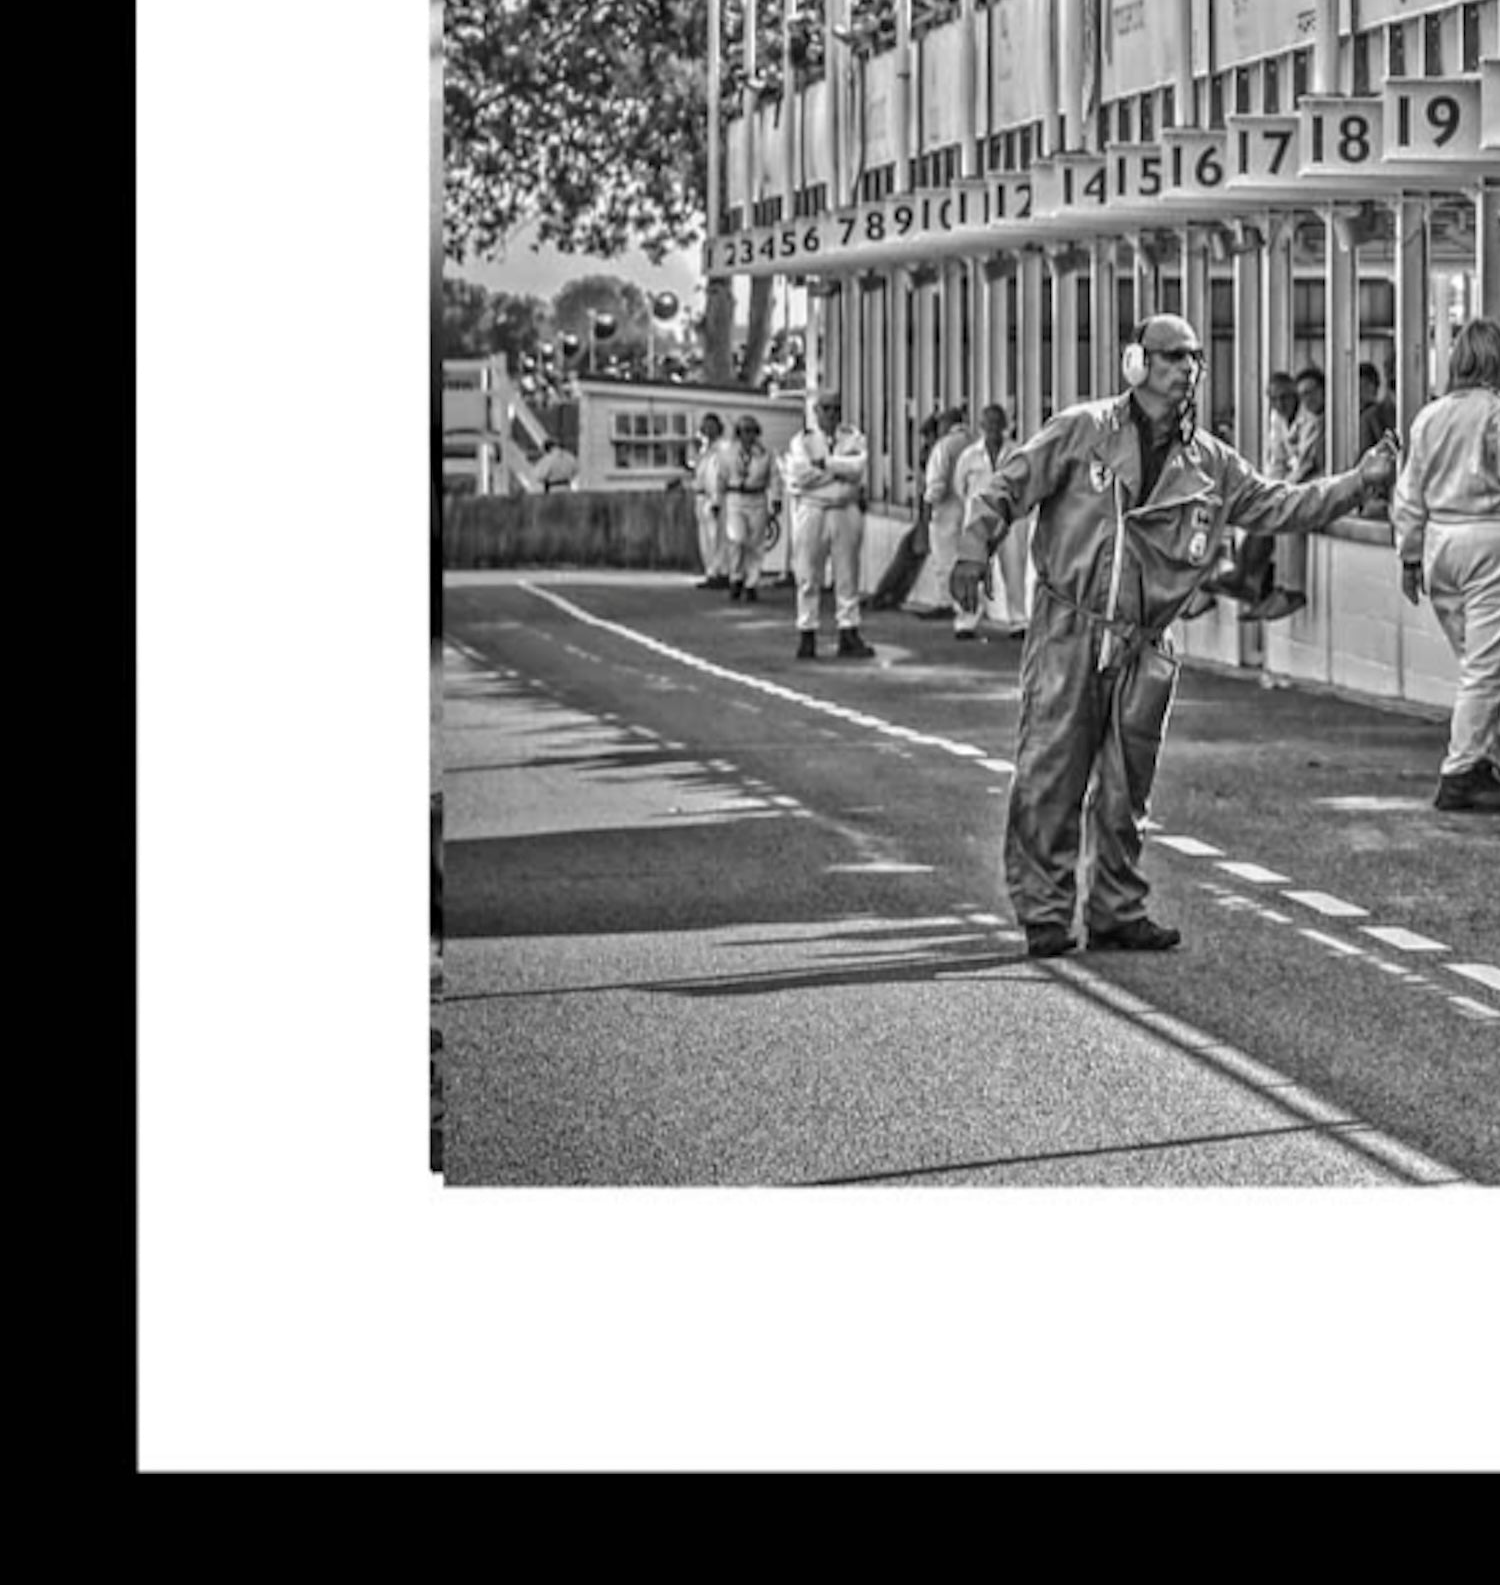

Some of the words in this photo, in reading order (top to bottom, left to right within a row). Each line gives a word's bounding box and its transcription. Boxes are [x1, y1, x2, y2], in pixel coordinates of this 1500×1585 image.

[1398, 95, 1460, 148] 19
[1239, 130, 1293, 175] 17
[1311, 114, 1370, 163] 18
[1117, 156, 1161, 196] 15
[1172, 145, 1223, 187] 16
[997, 184, 1031, 219] 12
[1063, 166, 1106, 205] 14
[894, 205, 913, 235] 9
[959, 191, 989, 225] 11
[803, 226, 820, 253] 6
[838, 217, 855, 246] 7
[866, 212, 885, 241] 8
[725, 242, 735, 266] 2
[740, 240, 753, 264] 3
[760, 235, 774, 261] 4
[780, 231, 796, 257] 5
